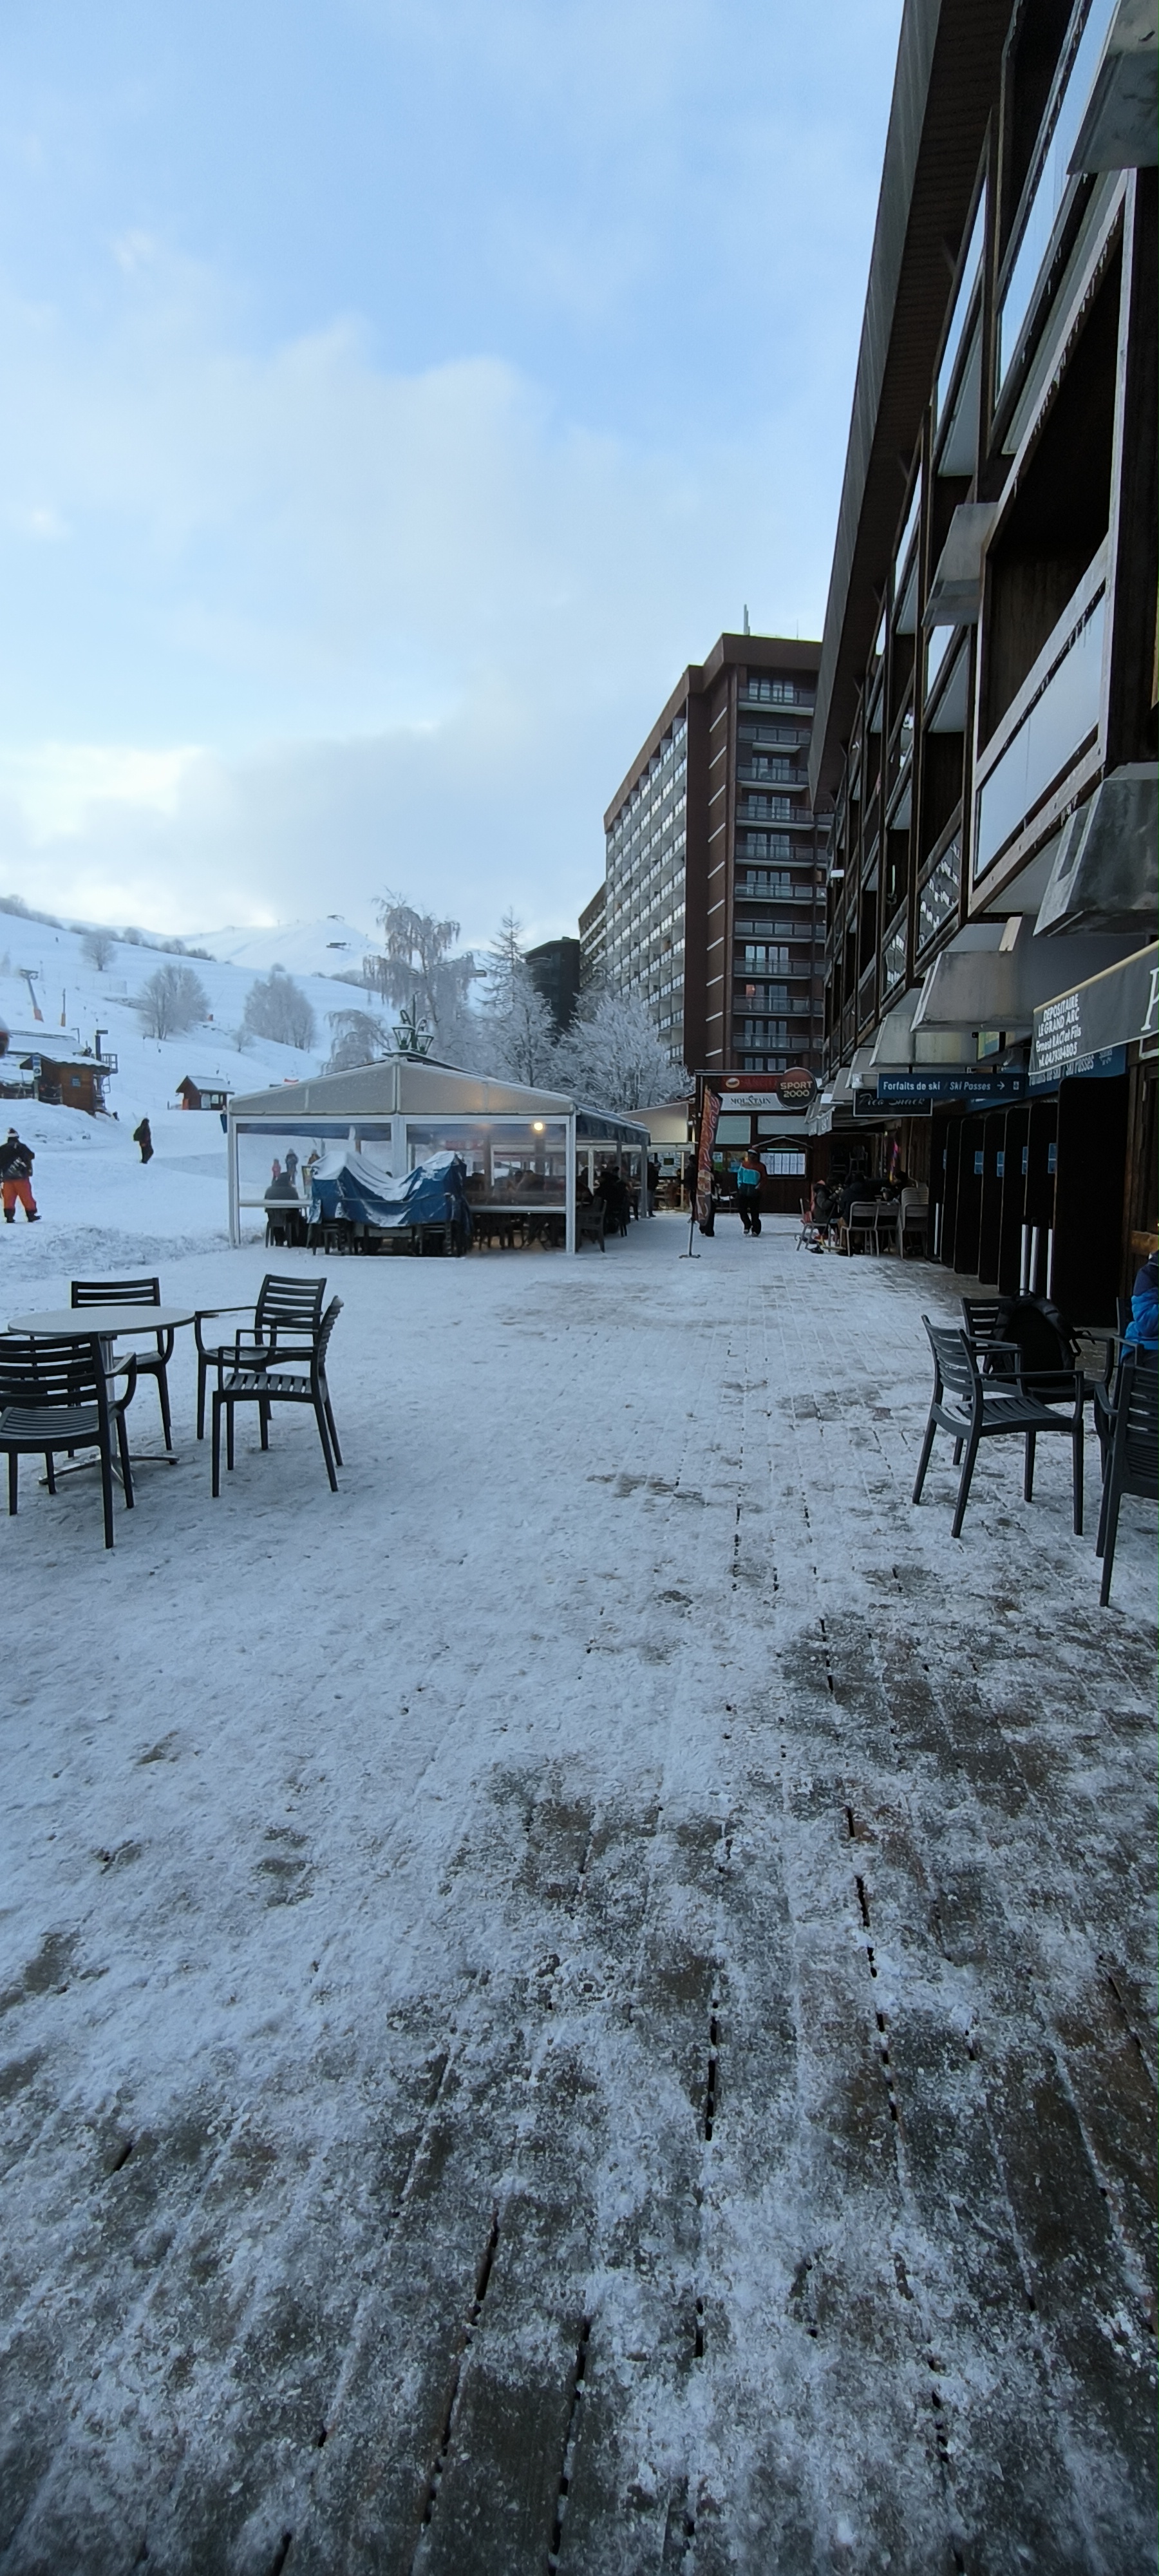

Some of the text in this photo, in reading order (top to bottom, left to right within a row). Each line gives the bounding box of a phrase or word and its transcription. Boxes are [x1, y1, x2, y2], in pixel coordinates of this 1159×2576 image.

[1038, 1007, 1080, 1037] LE GRAND ARC
[780, 1081, 813, 1090] SPORT
[883, 1081, 915, 1090] Forfaits
[916, 1081, 926, 1090] de
[928, 1081, 941, 1090] ski
[950, 1081, 962, 1090] Ski
[963, 1081, 991, 1090] Passes
[783, 1090, 810, 1098] 2000
